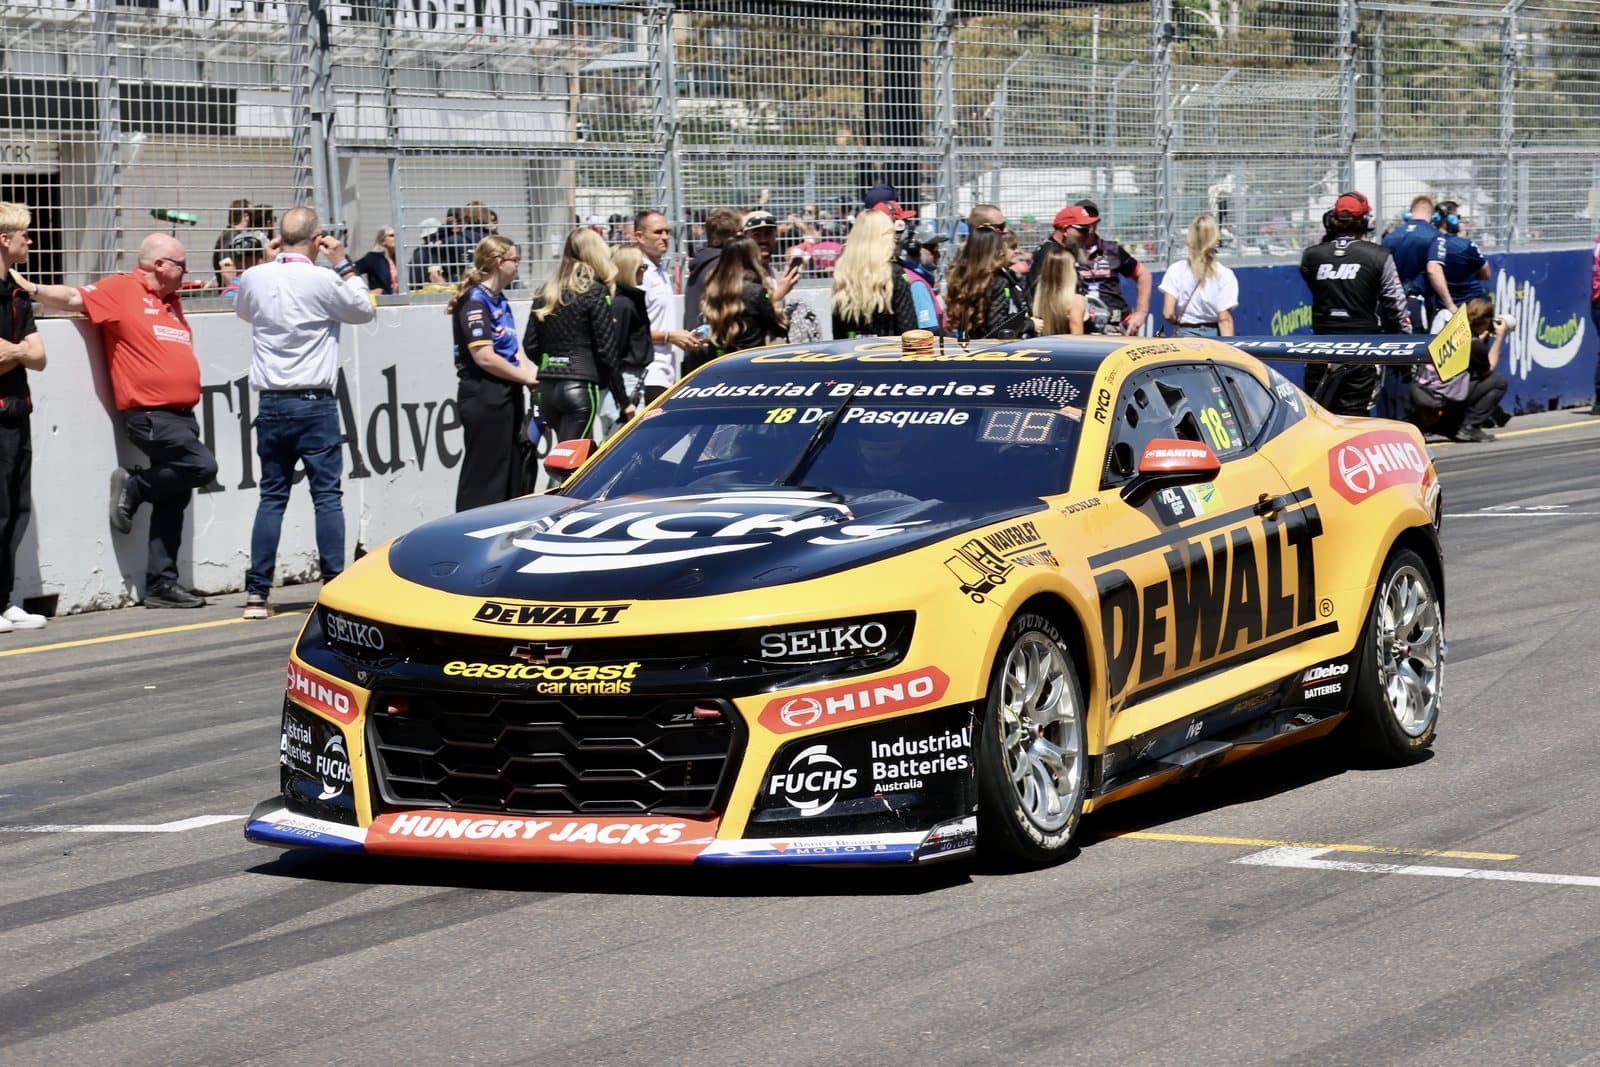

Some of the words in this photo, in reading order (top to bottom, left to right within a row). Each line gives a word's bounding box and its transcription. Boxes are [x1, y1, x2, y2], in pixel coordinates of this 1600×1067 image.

[394, 0, 560, 42] ADELAIDE
[1316, 263, 1361, 280] BJR
[1222, 341, 1425, 350] HEVROLET
[1286, 348, 1416, 357] RACING
[1437, 335, 1457, 368] JAX
[670, 381, 821, 400] Industrial
[828, 381, 996, 397] Batteries
[764, 408, 798, 423] 18
[842, 408, 970, 429] Pasquale
[1094, 388, 1111, 425] RYCO
[1199, 407, 1231, 450] 18
[1155, 448, 1207, 458] MANITOU
[1364, 442, 1426, 475] HINO
[1064, 497, 1101, 514] DUNLOP
[983, 521, 1041, 552] WAVERLEY
[326, 612, 385, 651] SEIKO
[760, 621, 888, 658] SEIKO
[443, 660, 642, 681] eastcoast
[1302, 663, 1350, 683] ACDelco
[296, 674, 350, 714] HINO
[536, 682, 567, 695] car
[569, 680, 632, 695] rentals
[825, 675, 934, 715] HINO
[1304, 682, 1342, 700] BATTERIES
[871, 727, 971, 758] Industrial
[316, 755, 352, 783] FUCHS
[872, 753, 969, 780] Batteries
[769, 768, 858, 795] FUCHS
[874, 778, 923, 793] Australia
[273, 824, 321, 839] MOTORS
[388, 814, 550, 841] HUNGRY
[551, 820, 687, 846] JACK'S
[795, 844, 888, 855] MOTORS
